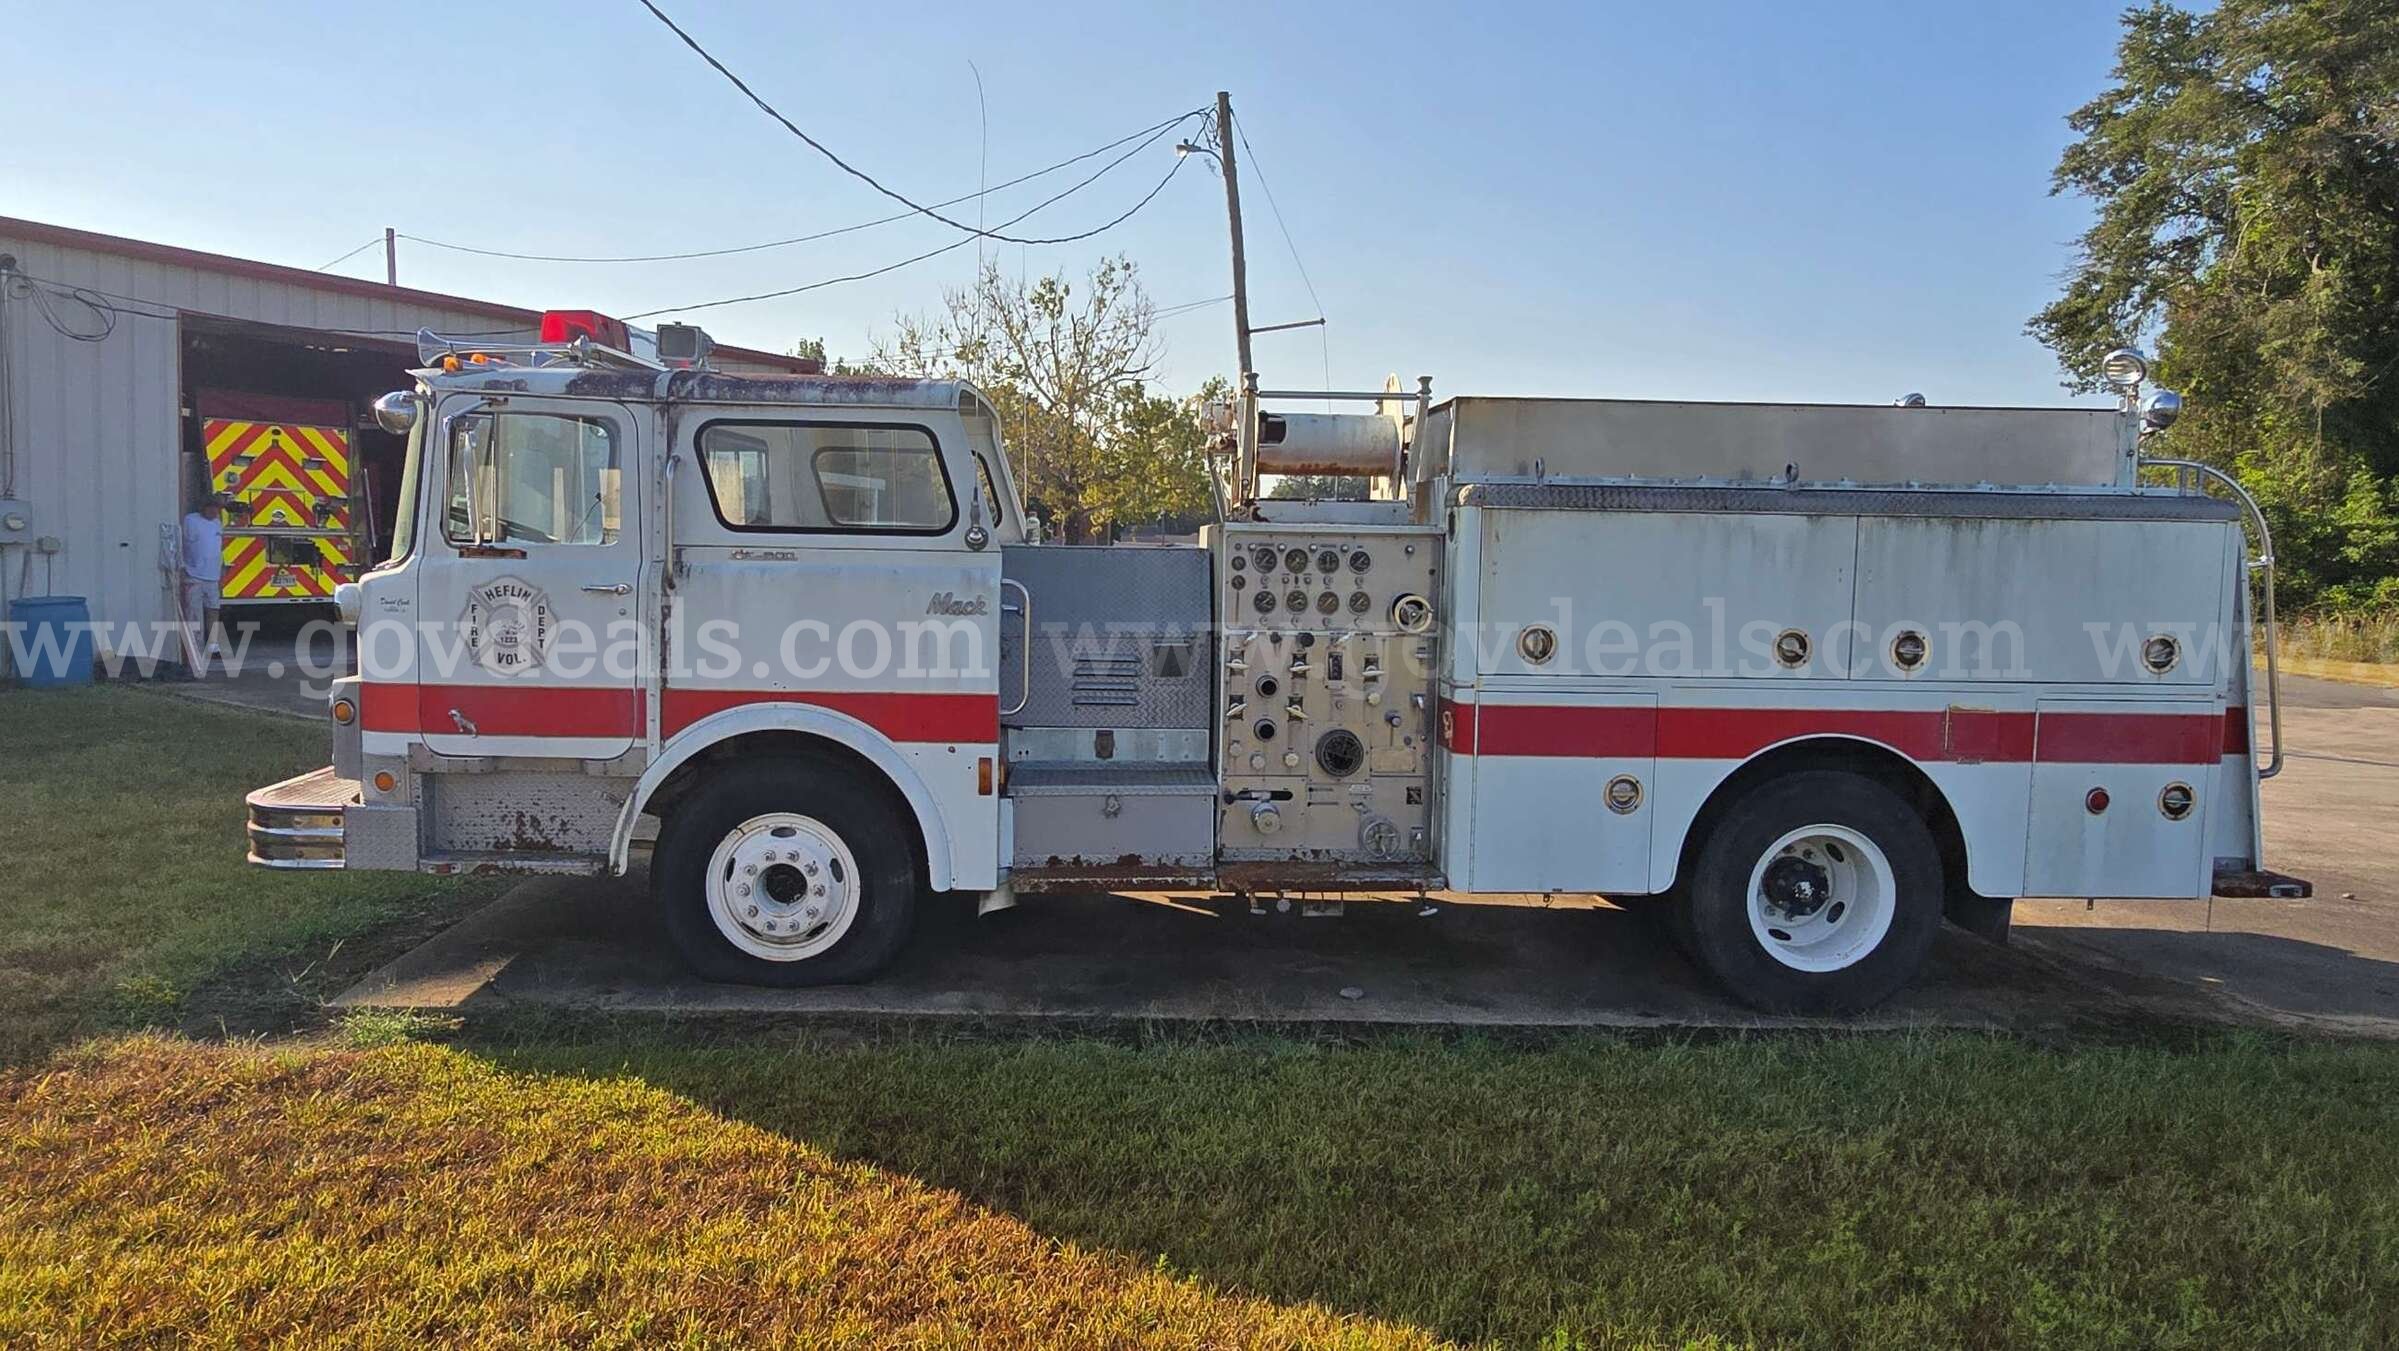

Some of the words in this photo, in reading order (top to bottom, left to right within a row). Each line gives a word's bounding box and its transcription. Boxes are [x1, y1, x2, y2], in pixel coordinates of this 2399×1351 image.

[484, 585, 531, 602] HEFLIN
[926, 591, 988, 616] Mack
[471, 604, 479, 648] FIRE
[538, 605, 546, 649] DEPT
[497, 652, 527, 665] VOL.
